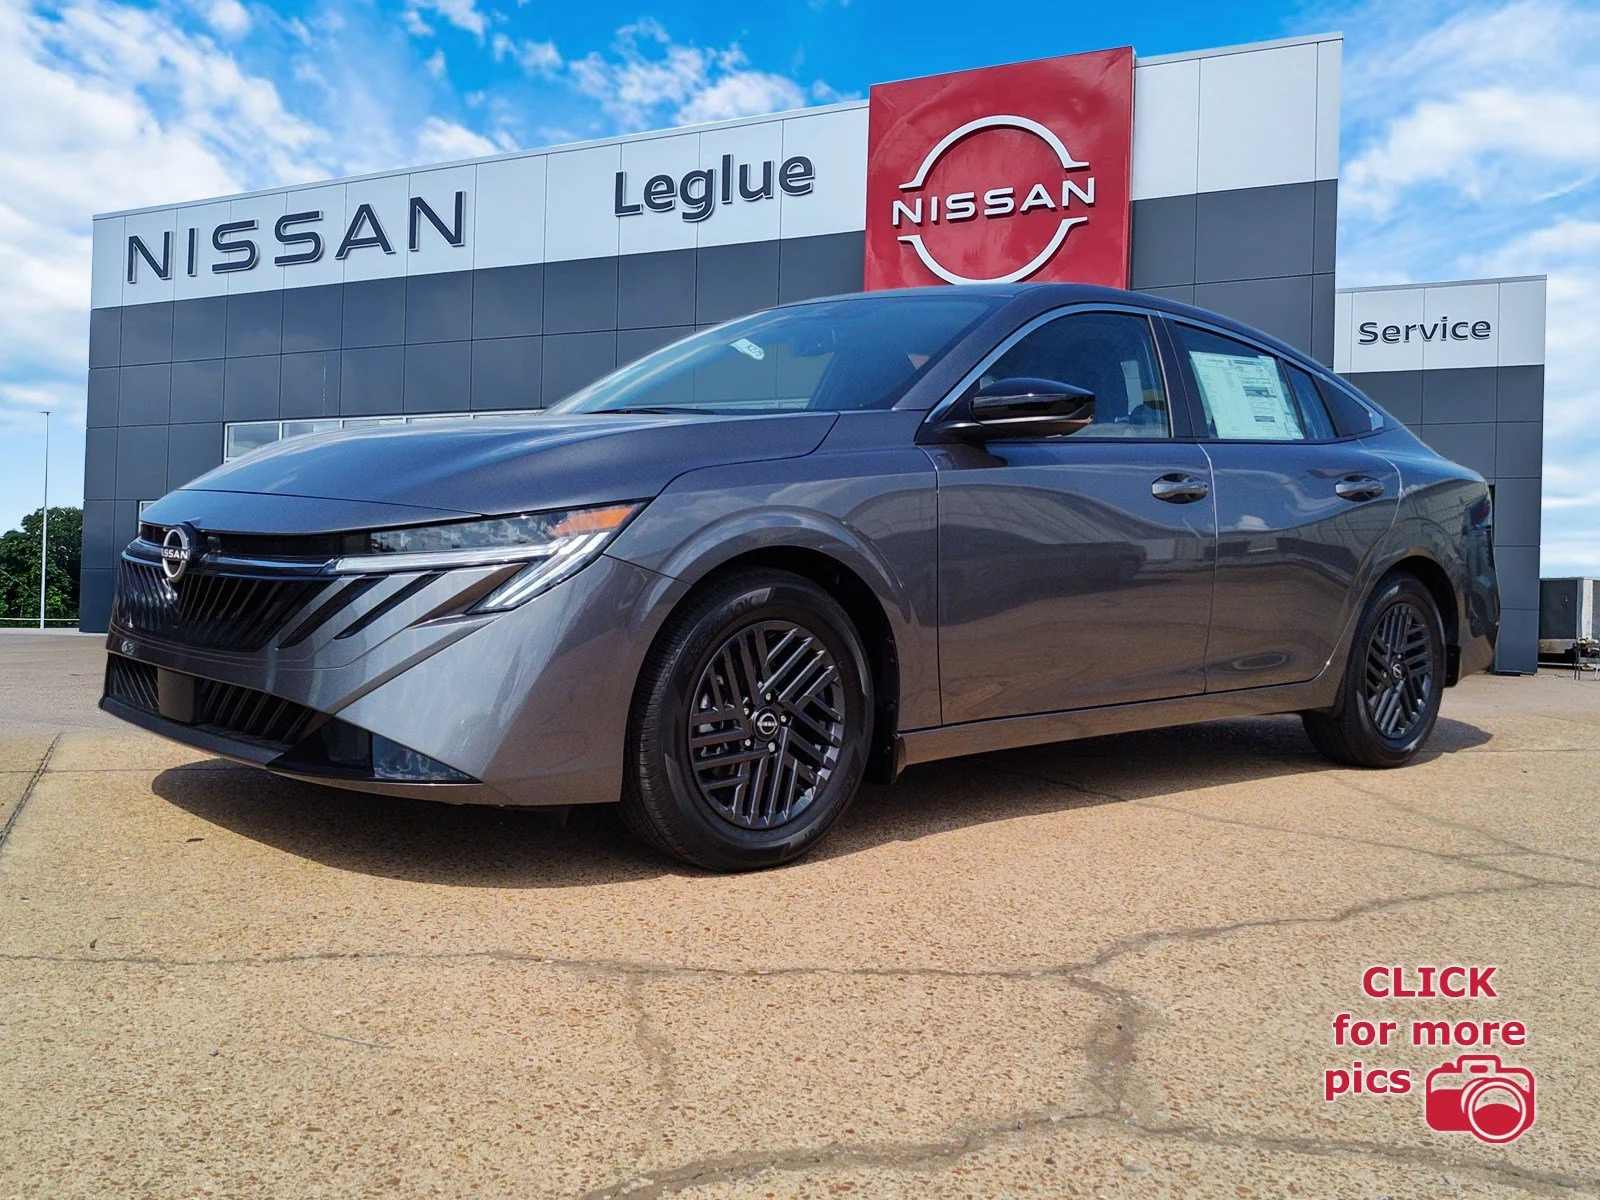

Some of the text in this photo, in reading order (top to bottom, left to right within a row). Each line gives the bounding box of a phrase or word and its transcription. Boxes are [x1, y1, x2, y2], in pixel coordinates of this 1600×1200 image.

[614, 153, 815, 221] Leglue
[892, 177, 1096, 226] NISSAN
[127, 190, 466, 284] NISSAN
[1358, 316, 1491, 345] Service
[163, 548, 188, 559] SSAN
